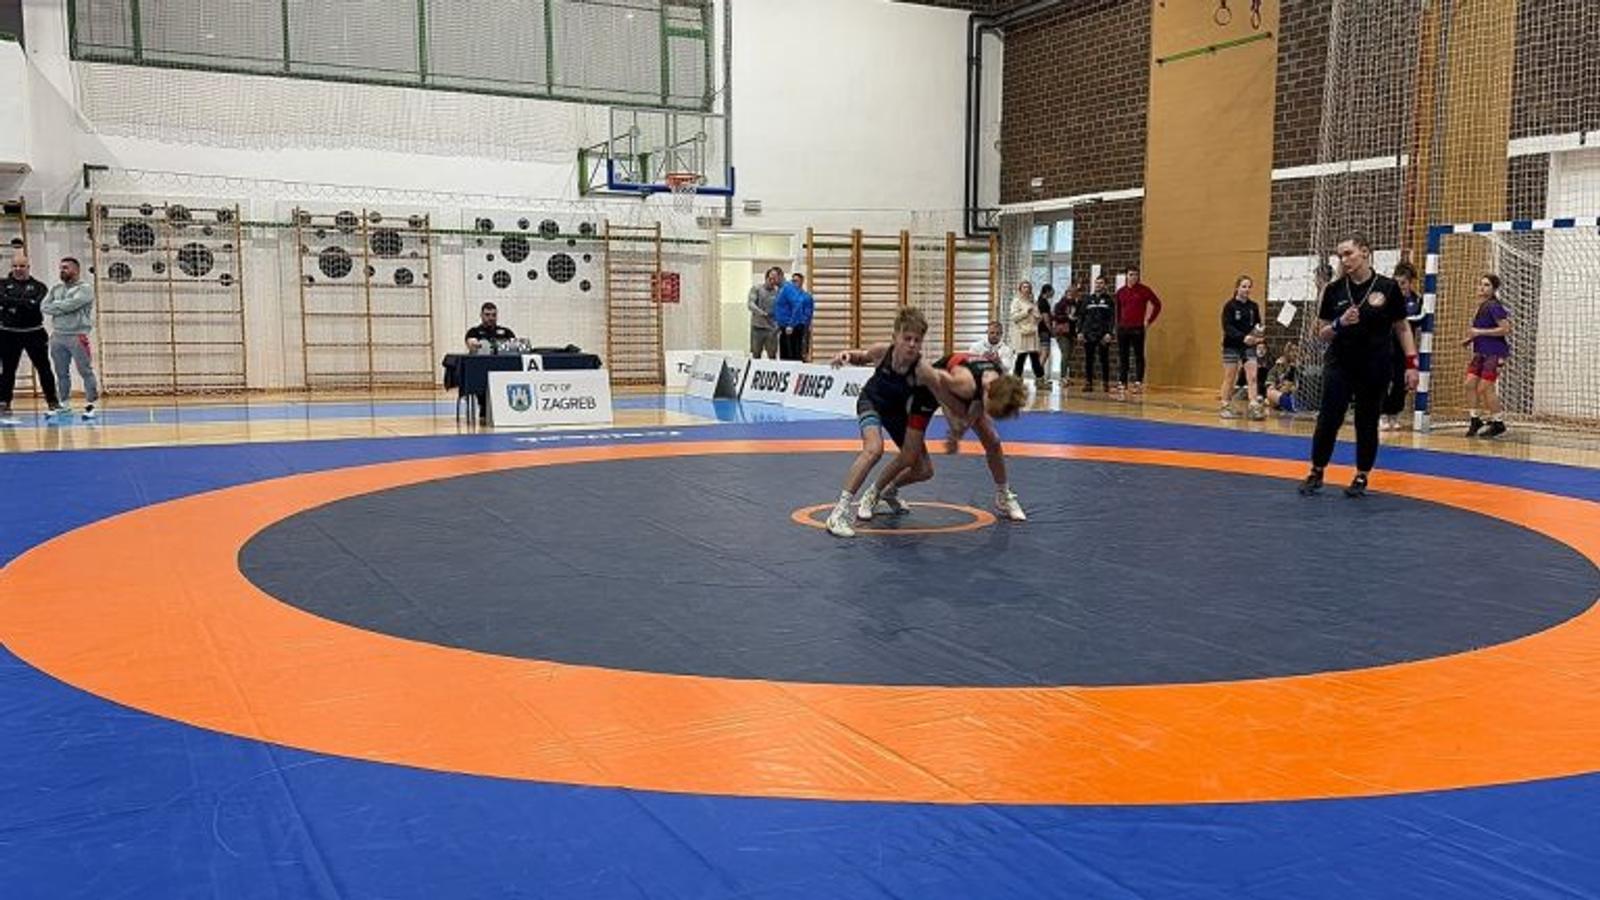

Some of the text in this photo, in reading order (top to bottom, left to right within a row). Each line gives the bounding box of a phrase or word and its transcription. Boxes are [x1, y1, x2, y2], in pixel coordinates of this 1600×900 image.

[527, 358, 540, 371] A
[750, 369, 791, 392] RUDIS
[540, 383, 571, 392] CITY OF
[541, 396, 597, 410] ZAGREB
